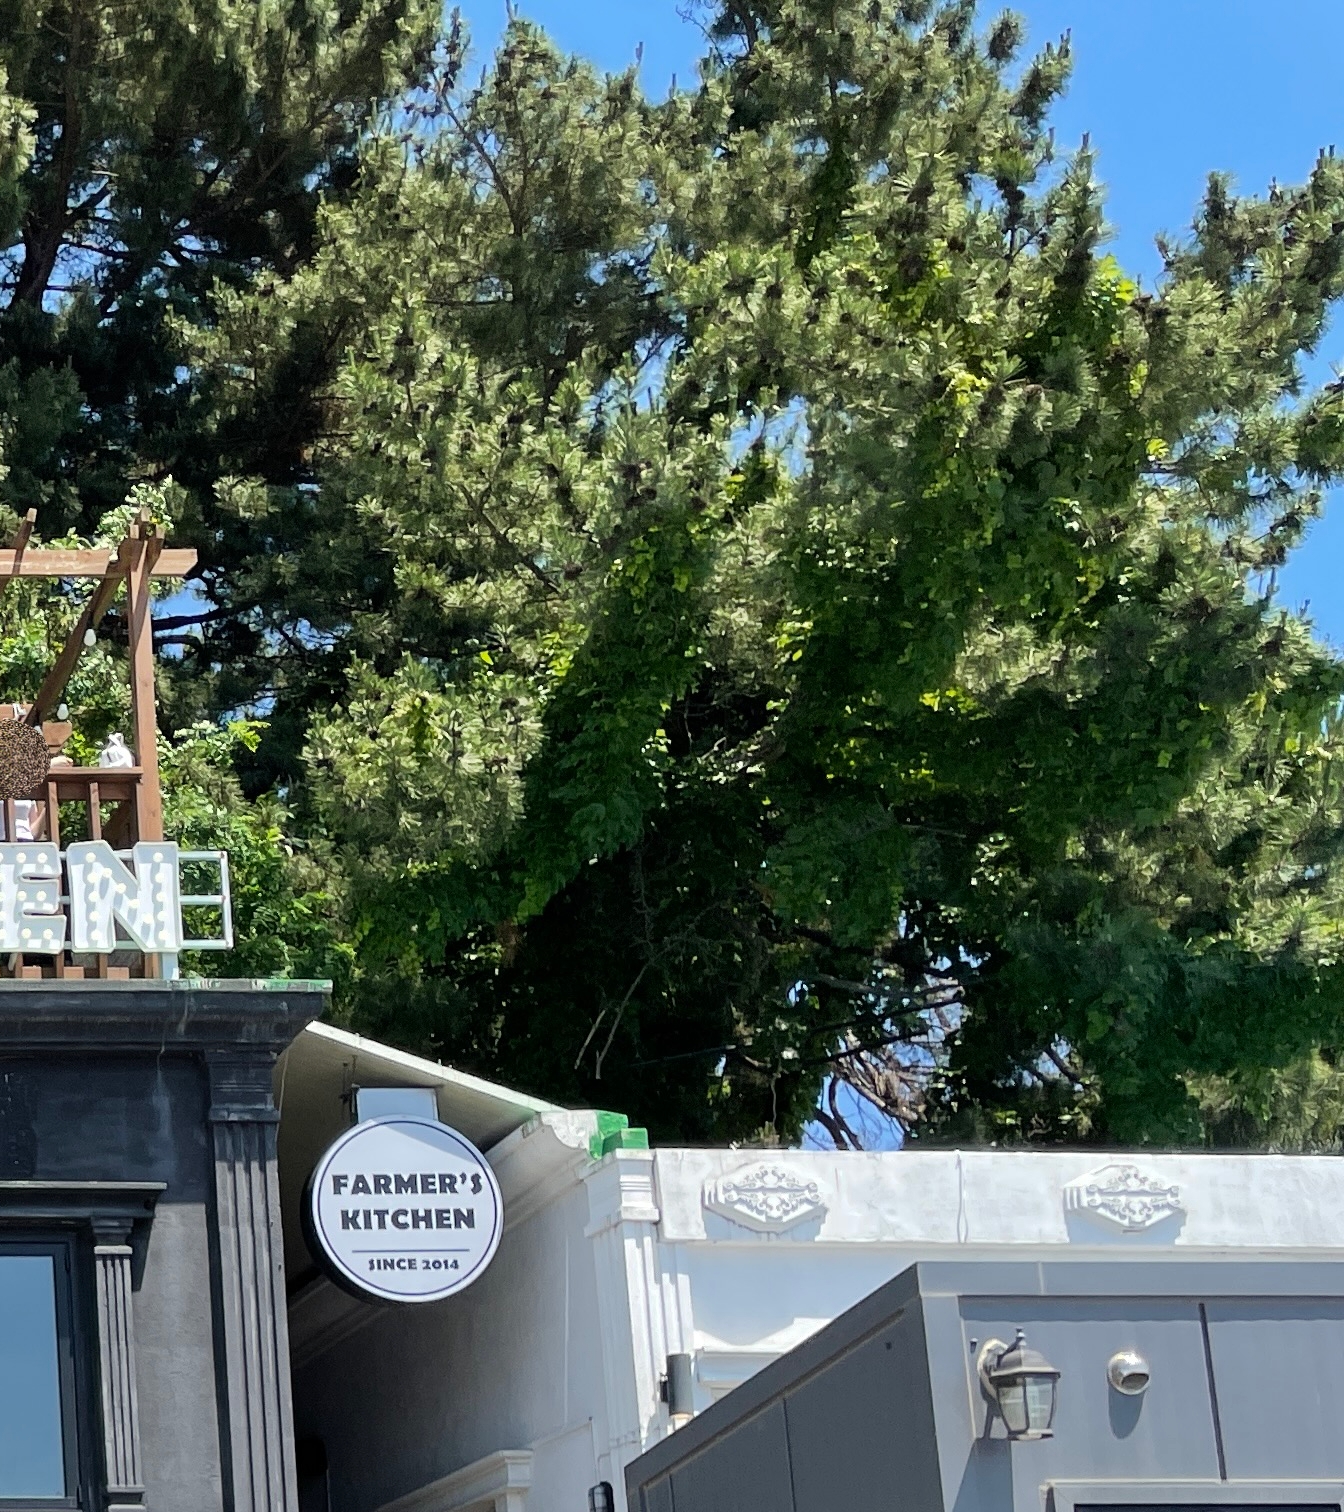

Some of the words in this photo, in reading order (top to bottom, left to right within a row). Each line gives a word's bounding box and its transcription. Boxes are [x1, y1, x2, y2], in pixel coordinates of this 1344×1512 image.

[331, 1172, 483, 1195] FARMER'S
[340, 1208, 476, 1230] KITCHEN
[368, 1258, 417, 1271] SINCE
[422, 1258, 459, 1270] 2014
